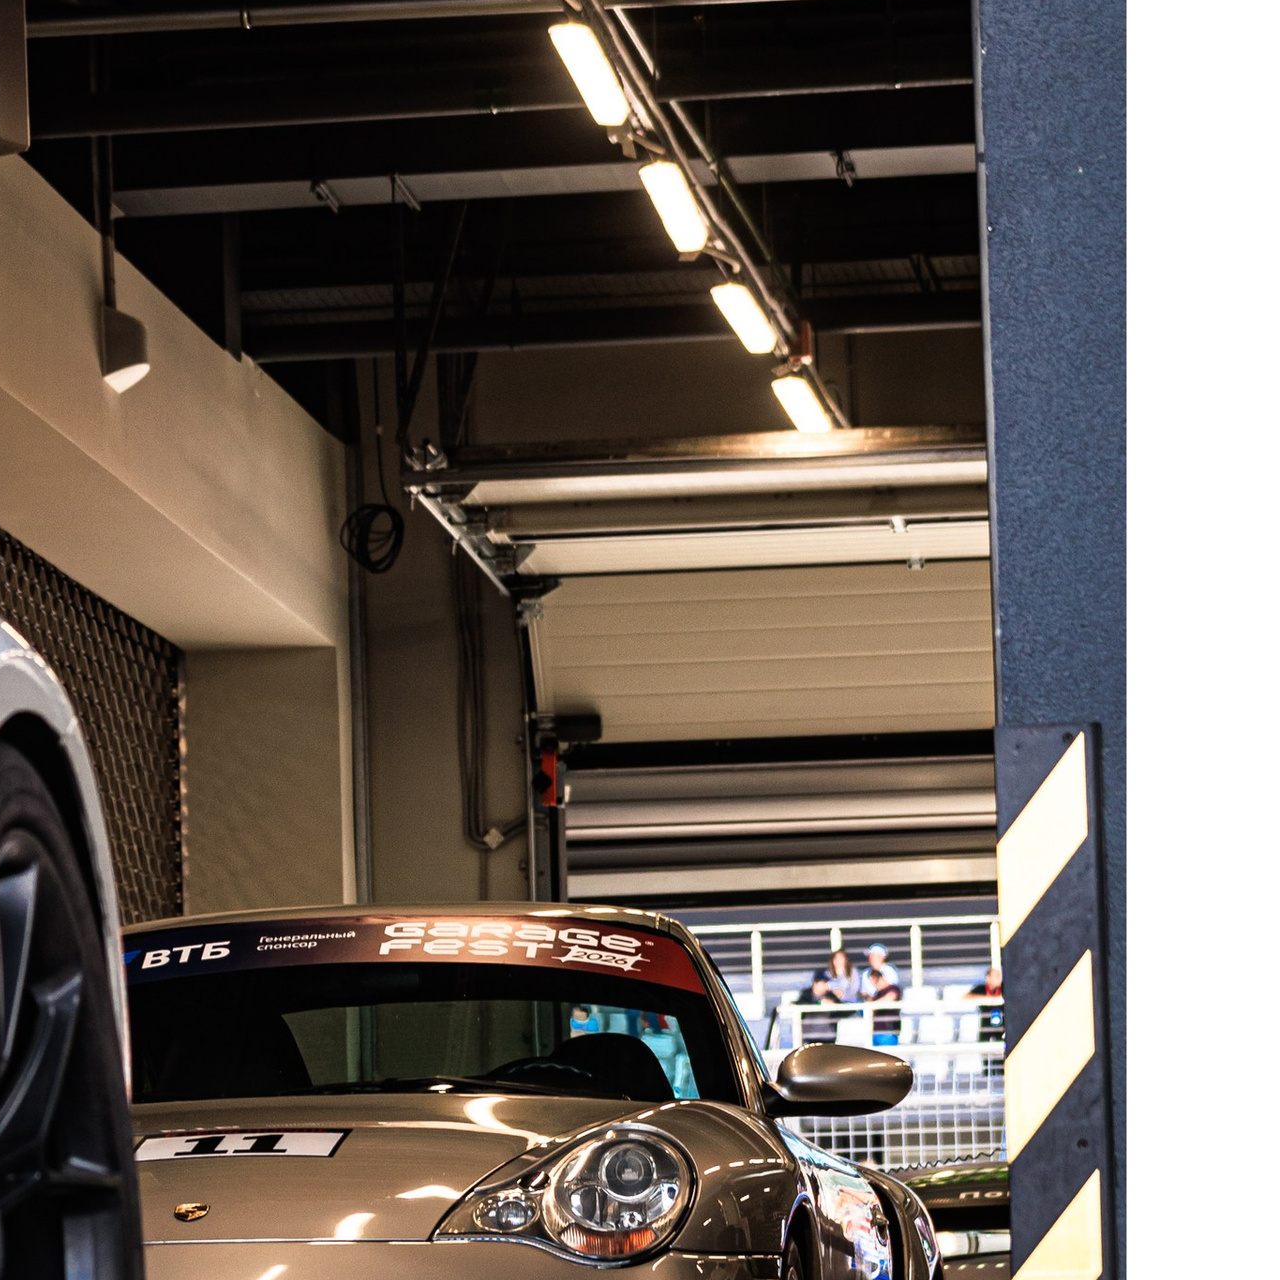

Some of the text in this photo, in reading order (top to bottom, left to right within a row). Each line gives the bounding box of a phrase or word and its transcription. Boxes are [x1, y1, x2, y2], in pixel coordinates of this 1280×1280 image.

[259, 930, 356, 944] Генеральный
[256, 940, 318, 951] спонсор
[141, 940, 231, 970] ВТБ
[572, 950, 628, 966] 2026
[174, 1133, 287, 1155] 11
